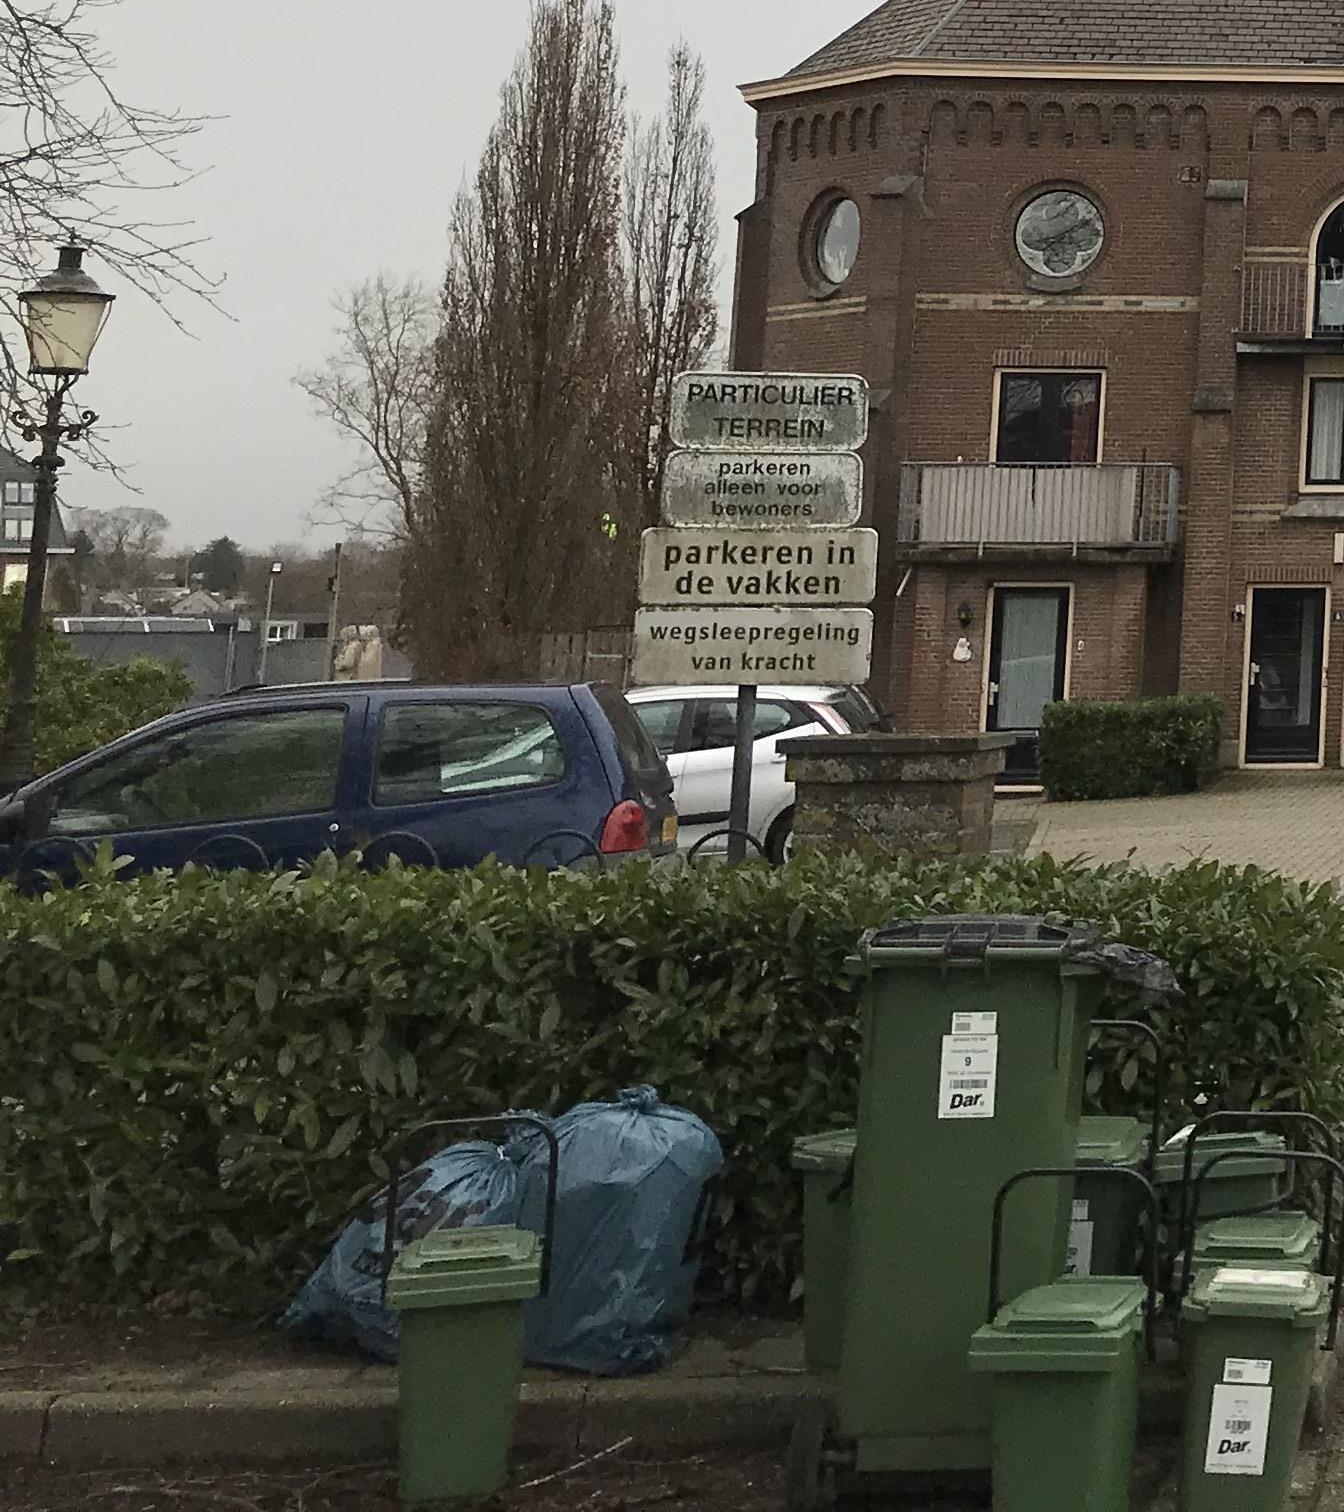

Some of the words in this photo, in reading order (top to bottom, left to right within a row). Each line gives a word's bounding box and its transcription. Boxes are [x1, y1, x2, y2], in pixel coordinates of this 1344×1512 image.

[688, 383, 854, 406] PARTICULIER
[713, 417, 825, 438] TERREIN
[718, 459, 812, 478] parkeren
[704, 479, 765, 496] alleen
[777, 482, 823, 496] voor
[711, 500, 813, 517] bewoners
[664, 539, 813, 572] parkeren
[827, 539, 855, 565] in
[675, 570, 714, 595] de
[726, 570, 840, 595] vakken
[649, 622, 860, 645] wegsleepregeling
[691, 655, 731, 671] van
[741, 652, 816, 671] kracht
[964, 1056, 972, 1067] 9
[949, 1093, 983, 1110] Dar
[1217, 1439, 1251, 1455] Dar
